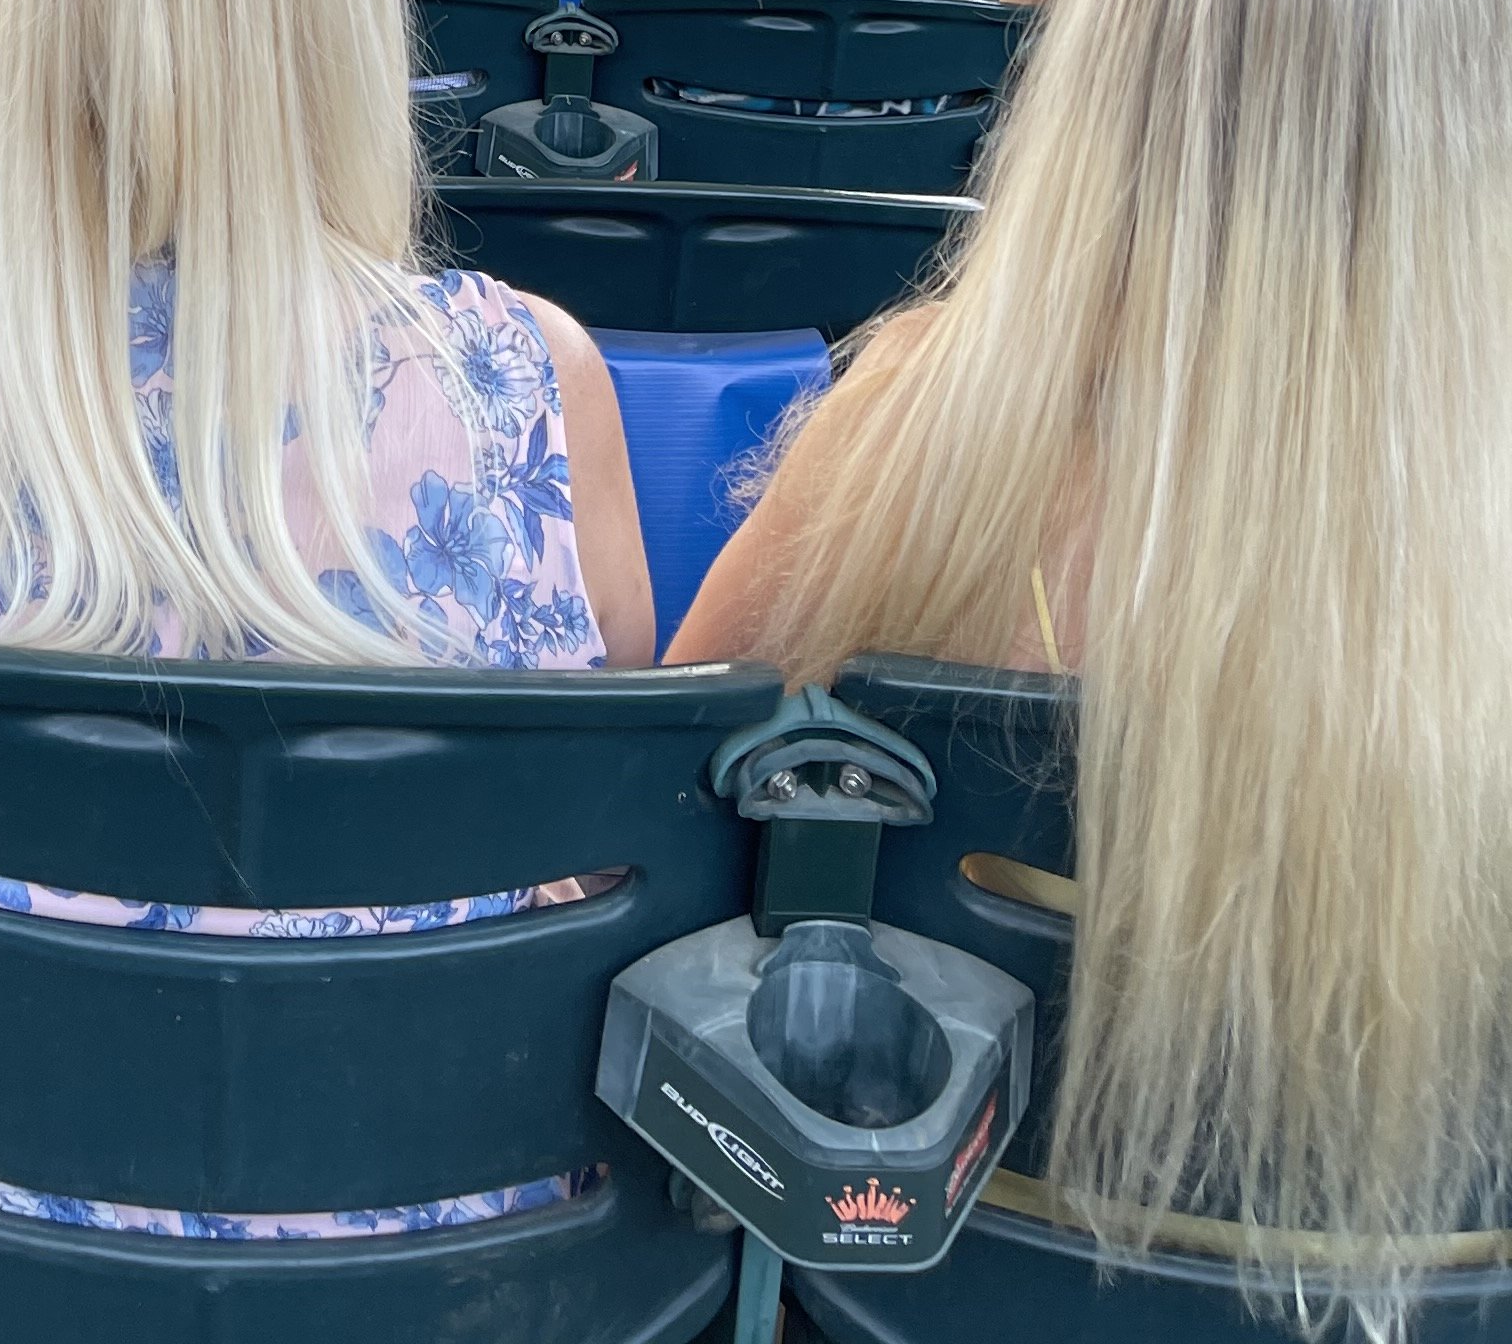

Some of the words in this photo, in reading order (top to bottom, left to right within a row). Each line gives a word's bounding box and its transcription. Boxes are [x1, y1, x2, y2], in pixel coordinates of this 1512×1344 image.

[660, 1082, 709, 1127] BUD
[717, 1131, 785, 1190] LIGHT
[822, 1233, 913, 1246] SELECT
